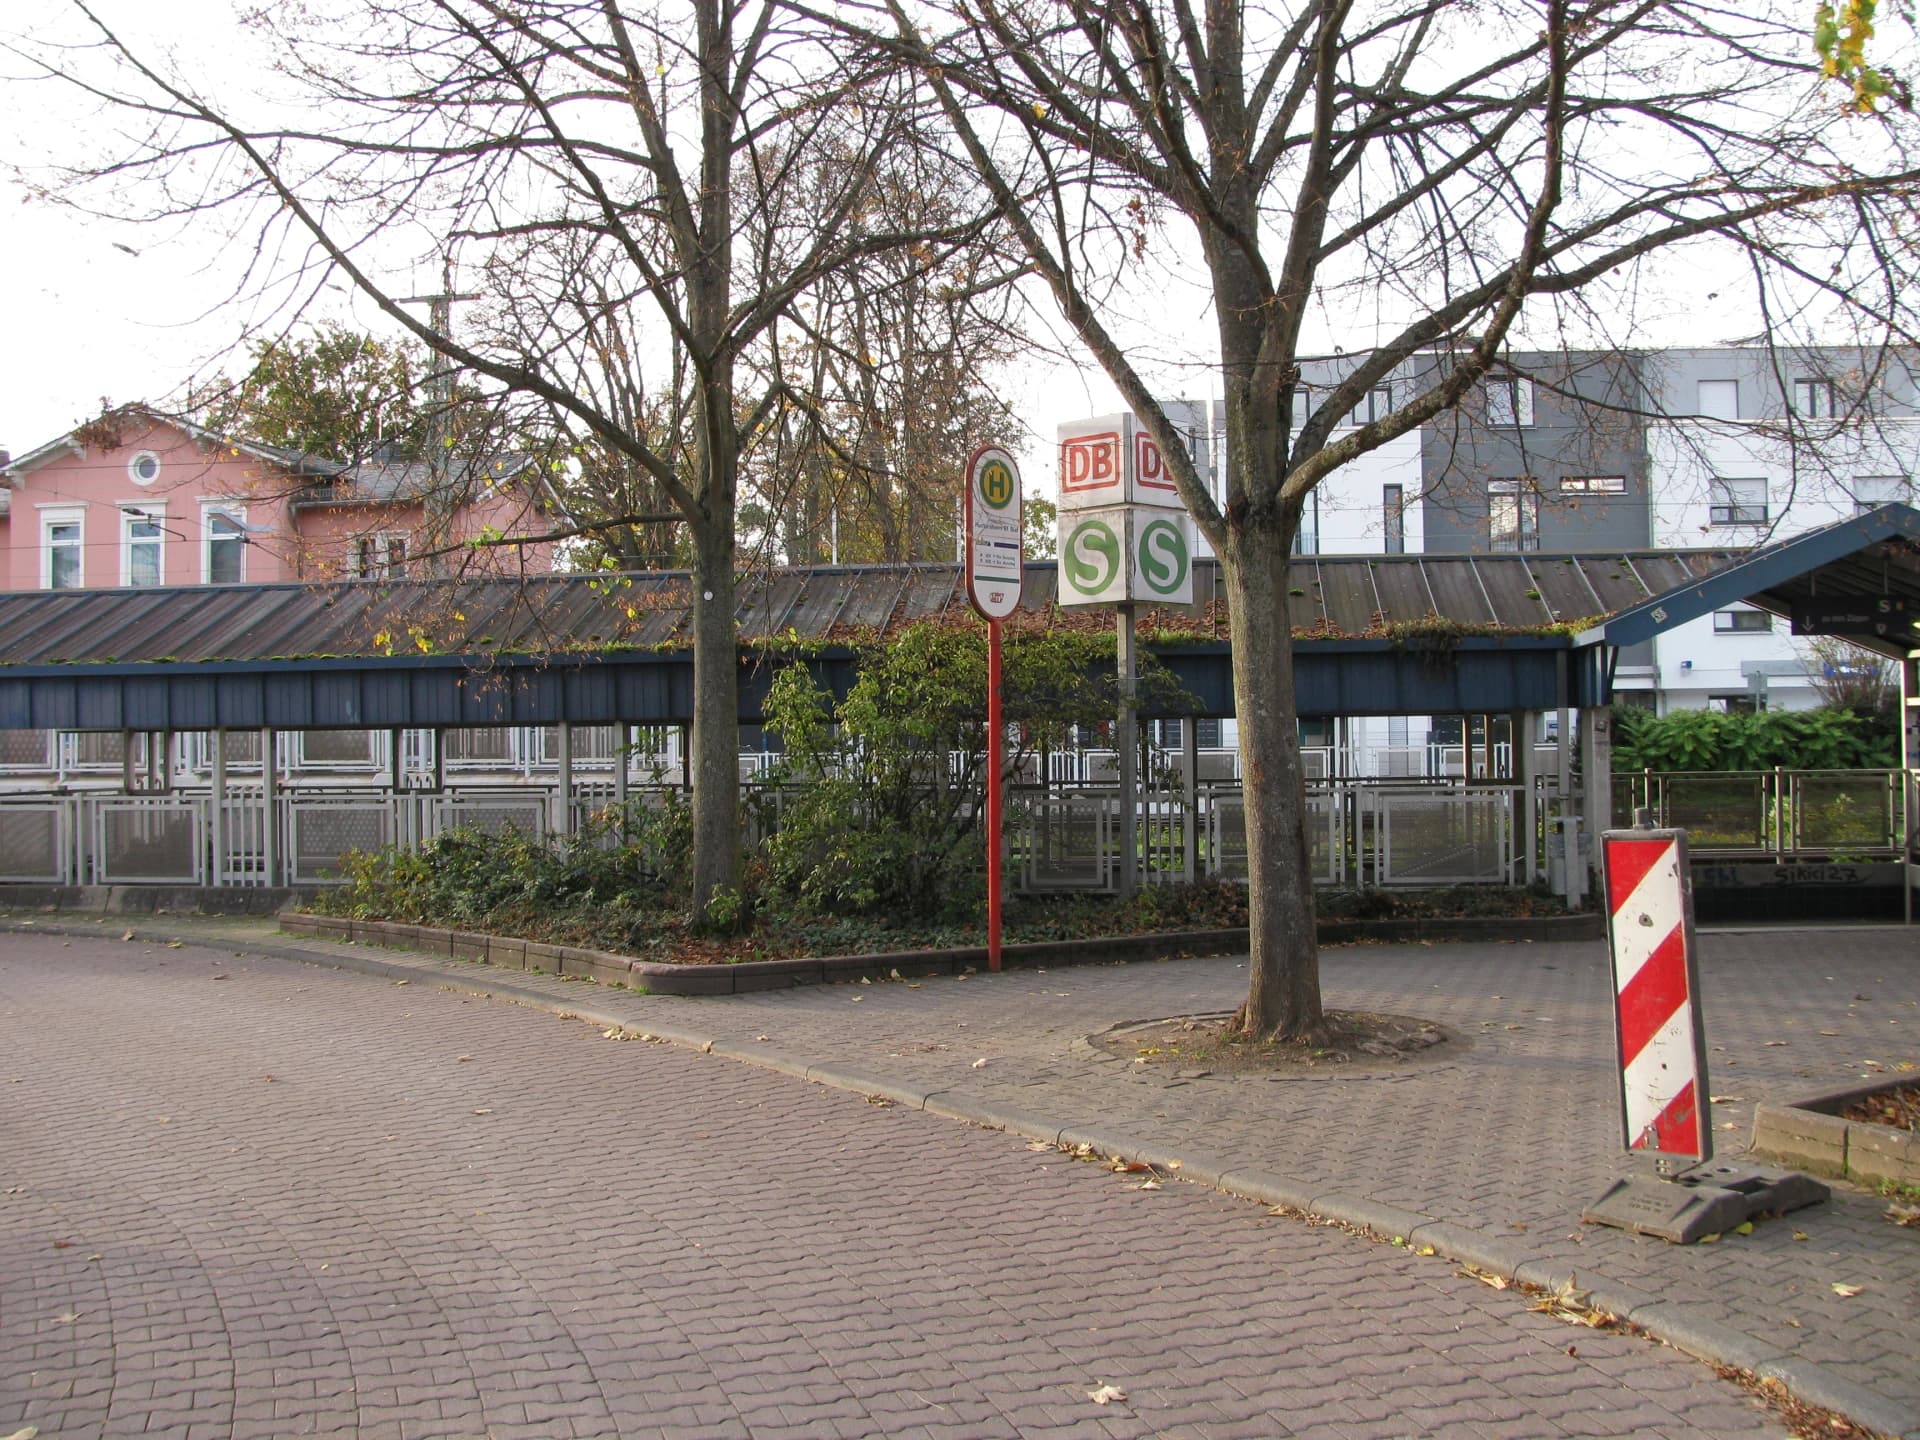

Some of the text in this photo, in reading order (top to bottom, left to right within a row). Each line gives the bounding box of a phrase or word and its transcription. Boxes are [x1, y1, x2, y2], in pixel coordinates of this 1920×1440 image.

[1069, 442, 1112, 483] DB
[1143, 441, 1173, 481] D
[988, 472, 1005, 498] H
[1074, 528, 1109, 588] S
[1148, 529, 1178, 586] S
